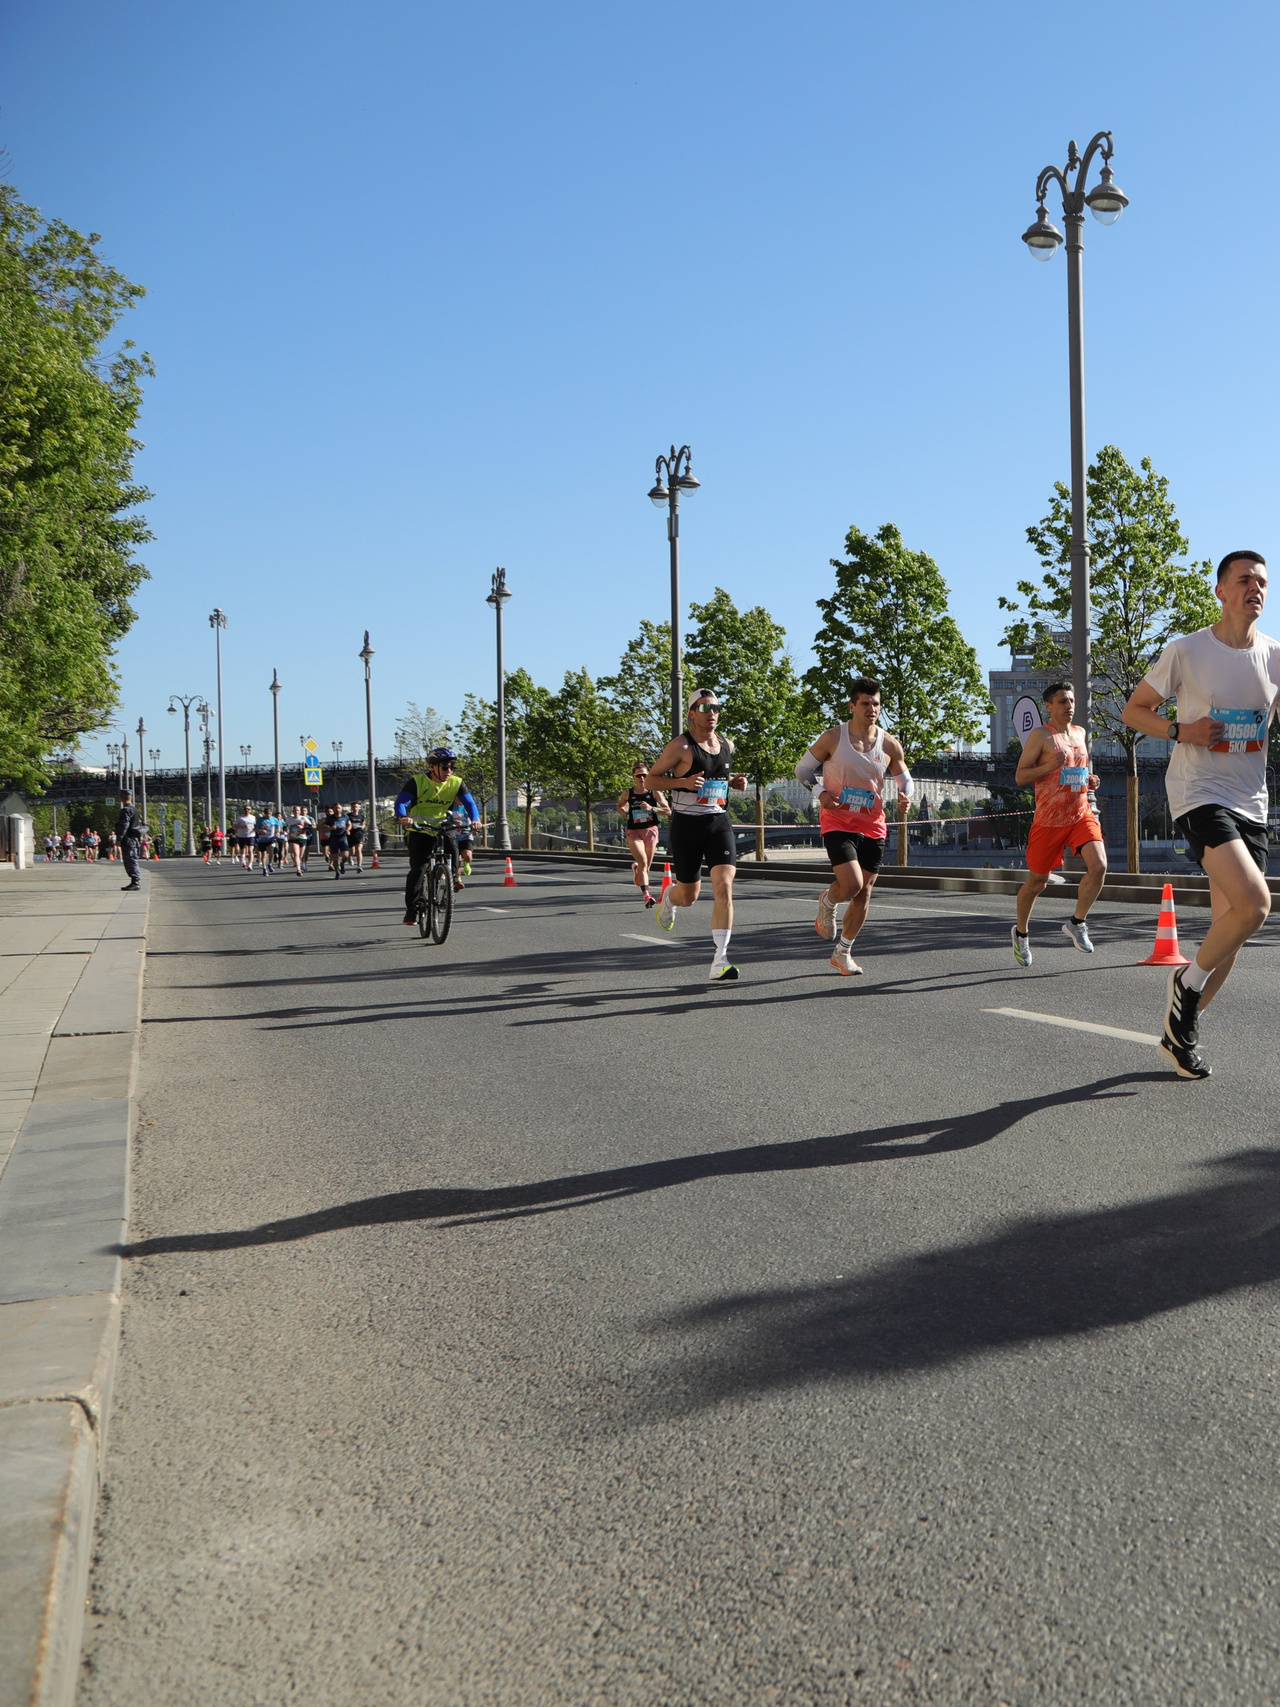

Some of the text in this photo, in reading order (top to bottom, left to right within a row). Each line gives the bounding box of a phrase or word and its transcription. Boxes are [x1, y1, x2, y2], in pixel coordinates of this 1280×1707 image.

[1223, 723, 1257, 739] 20586
[1229, 741, 1247, 753] 5KM
[846, 794, 868, 806] 21234
